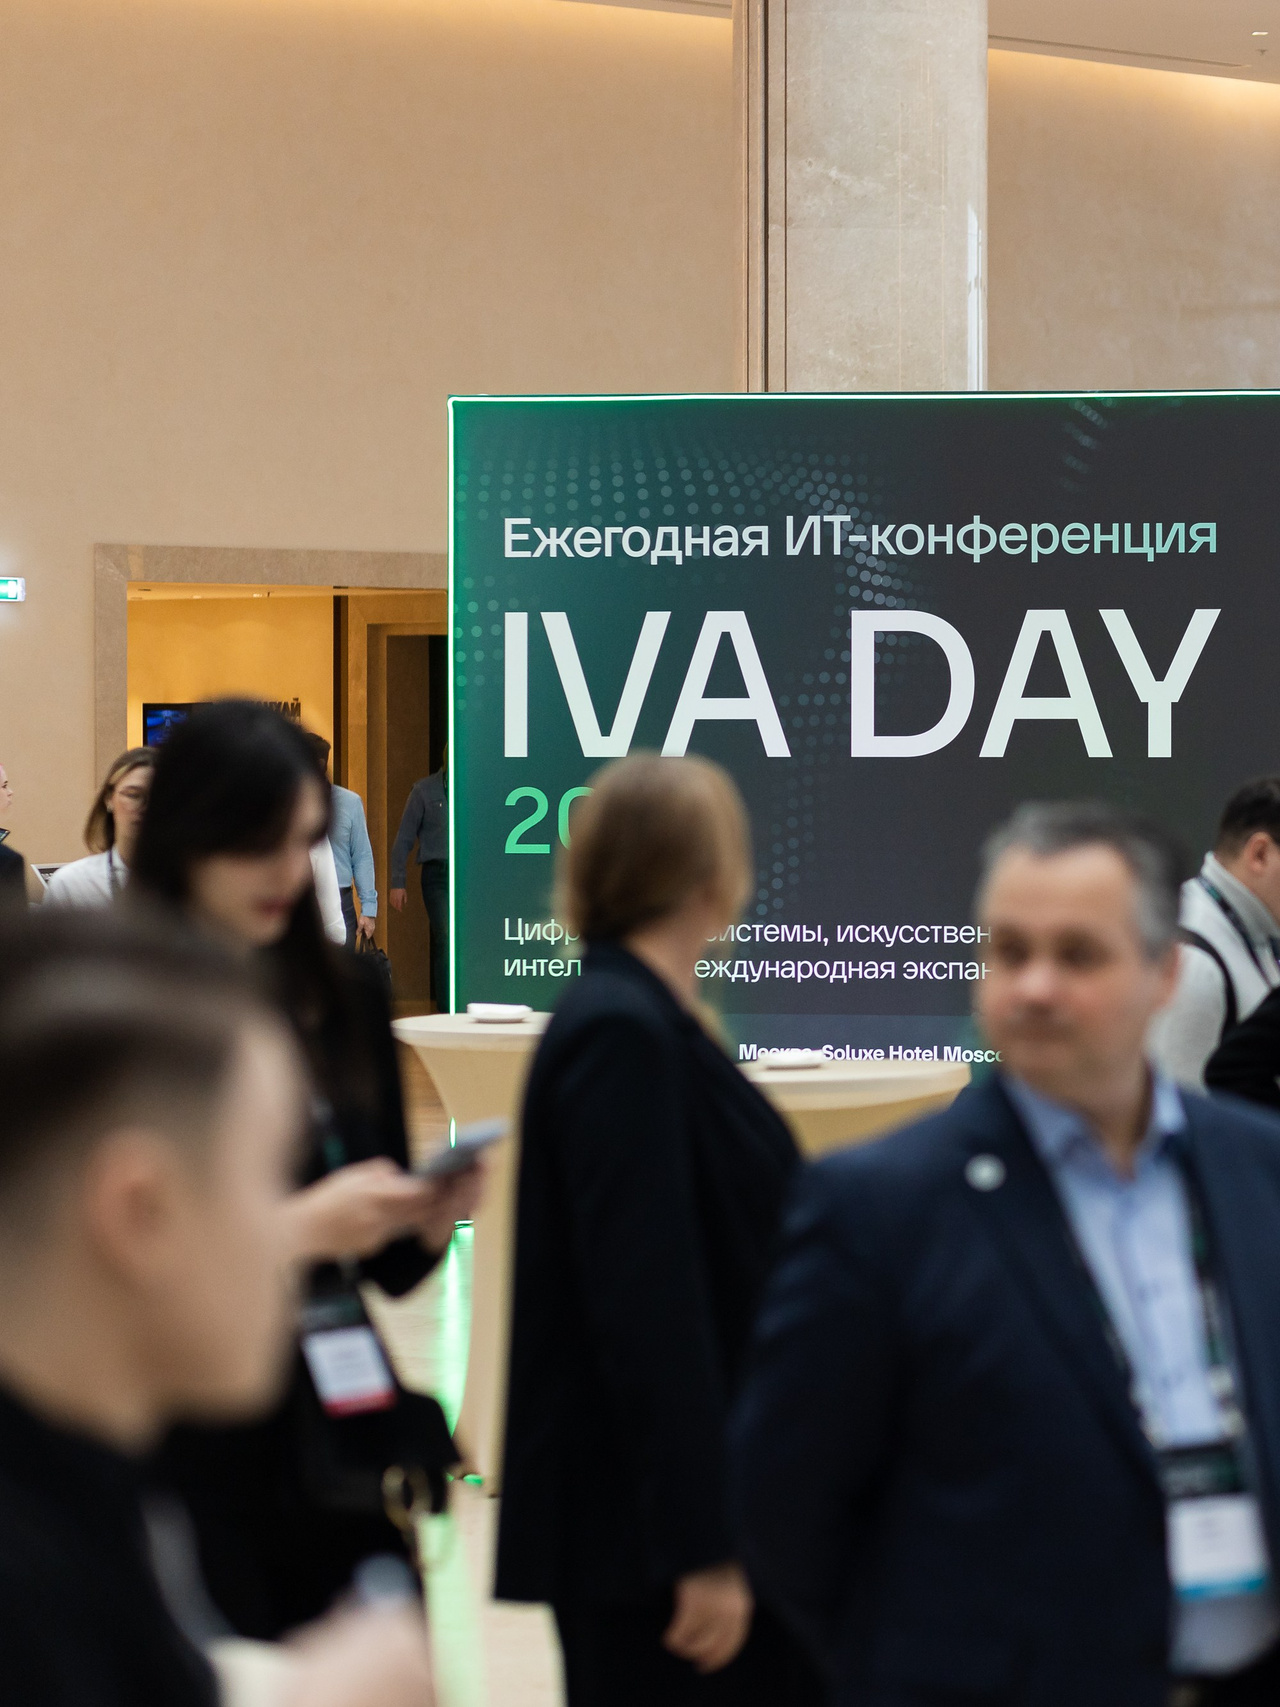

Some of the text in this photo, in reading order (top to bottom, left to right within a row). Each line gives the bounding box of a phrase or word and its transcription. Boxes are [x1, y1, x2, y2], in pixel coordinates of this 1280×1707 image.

[504, 514, 1217, 565] Ежегодная ИТ-конференция
[504, 608, 1222, 758] IVA DAY
[504, 786, 596, 854] 20
[504, 917, 581, 946] Цифр
[837, 924, 992, 948] искусствен
[504, 958, 992, 983] интел еждународная экспан
[821, 1044, 885, 1062] Soluxe
[889, 1045, 938, 1063] Hotel
